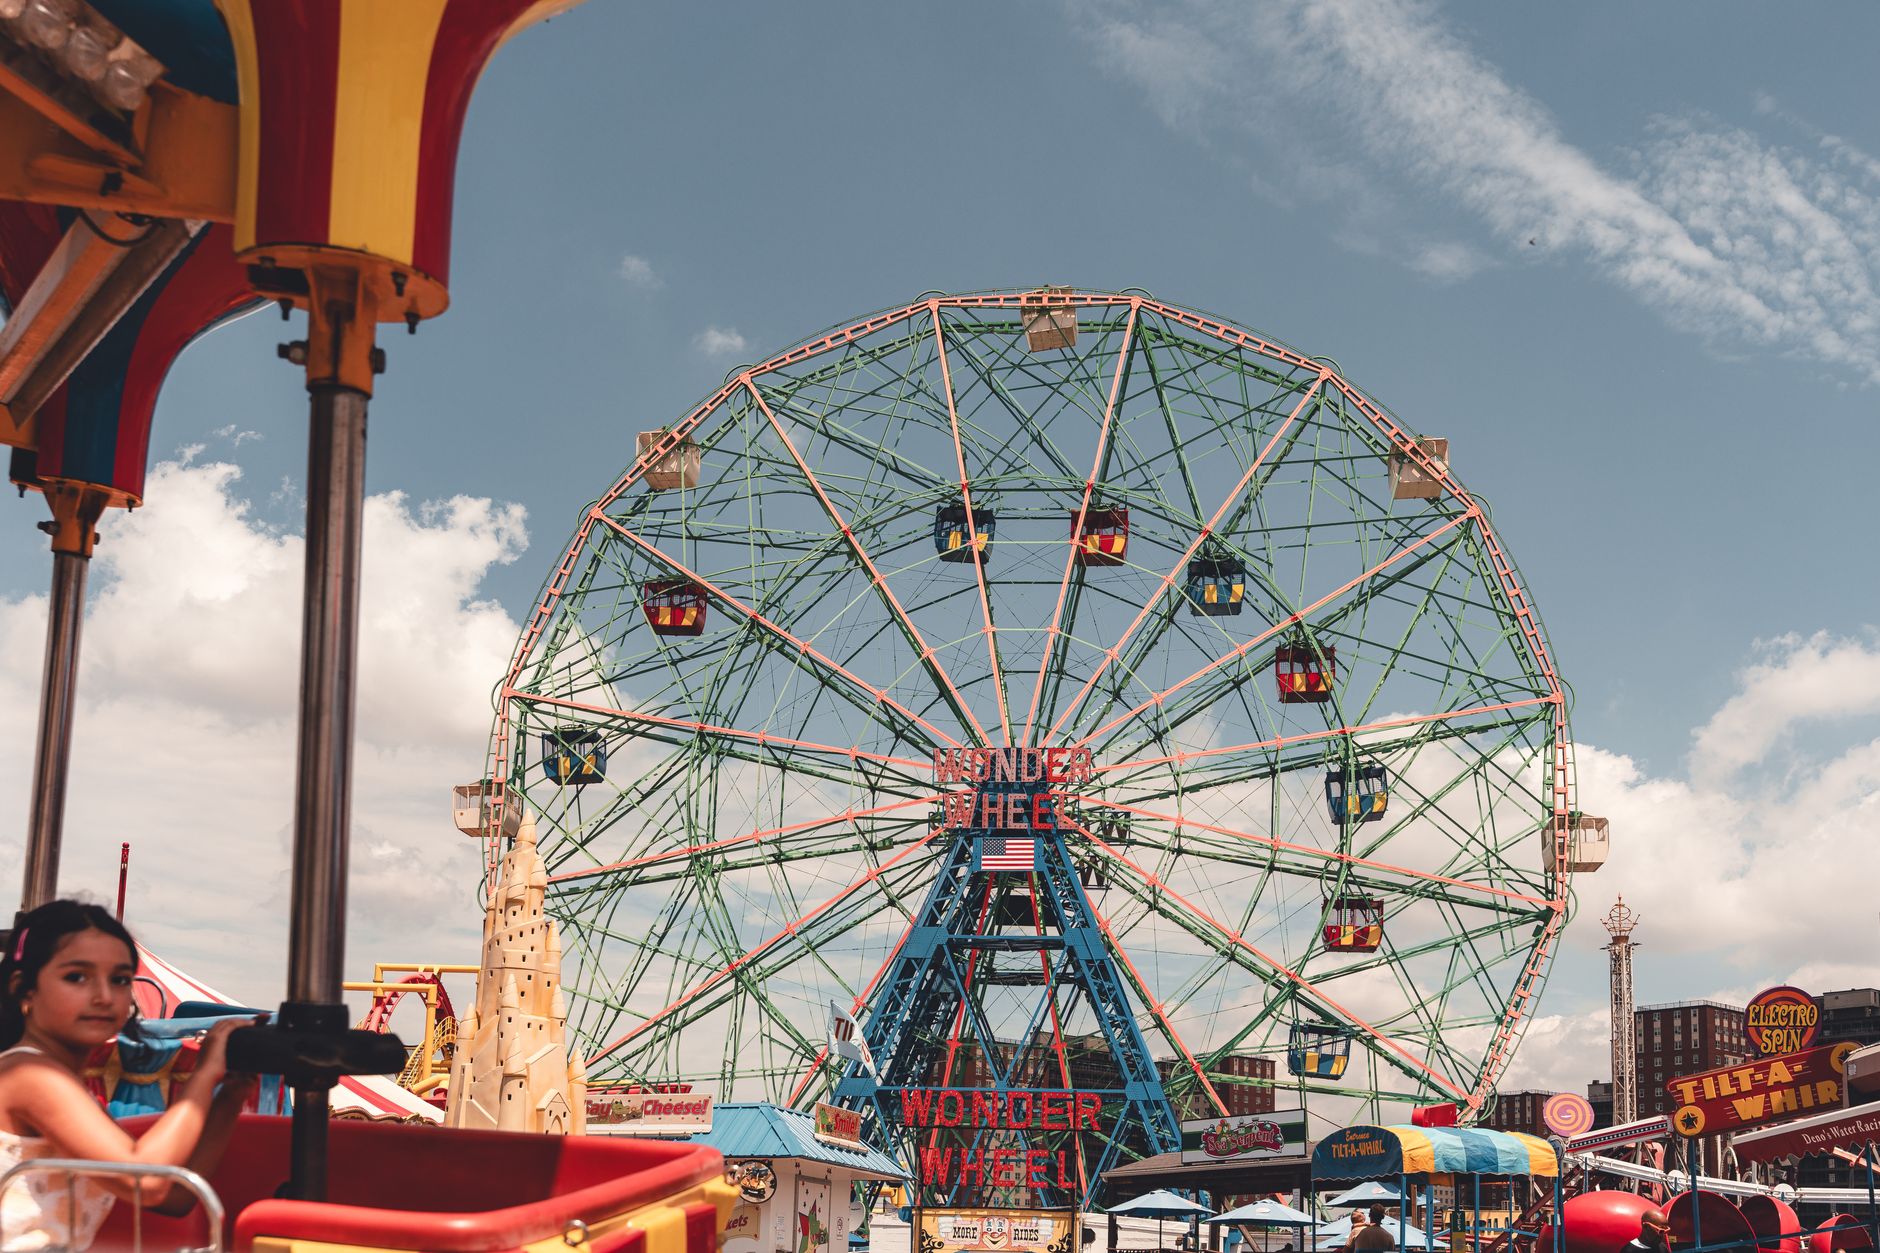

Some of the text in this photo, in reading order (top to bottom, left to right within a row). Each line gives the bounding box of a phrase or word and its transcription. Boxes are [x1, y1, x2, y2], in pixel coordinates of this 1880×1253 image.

[933, 748, 1091, 783] WONDER
[943, 793, 1079, 829] WHEEL
[1748, 1004, 1818, 1027] ELECTRO
[1760, 1028, 1803, 1054] SPIN
[642, 1099, 709, 1116] Cheese!
[901, 1088, 1102, 1130] WONDER
[1731, 1080, 1841, 1121] WHIR
[834, 1113, 857, 1135] Smile!
[1802, 1130, 1832, 1145] Deno's
[1830, 1125, 1857, 1139] Water
[1207, 1128, 1275, 1152] Sea Serpent
[1332, 1139, 1386, 1159] TILT-A-WHIRL
[920, 1146, 1076, 1188] WHEEL
[725, 1214, 749, 1231] kets
[953, 1226, 1039, 1242] MORE RIDES
